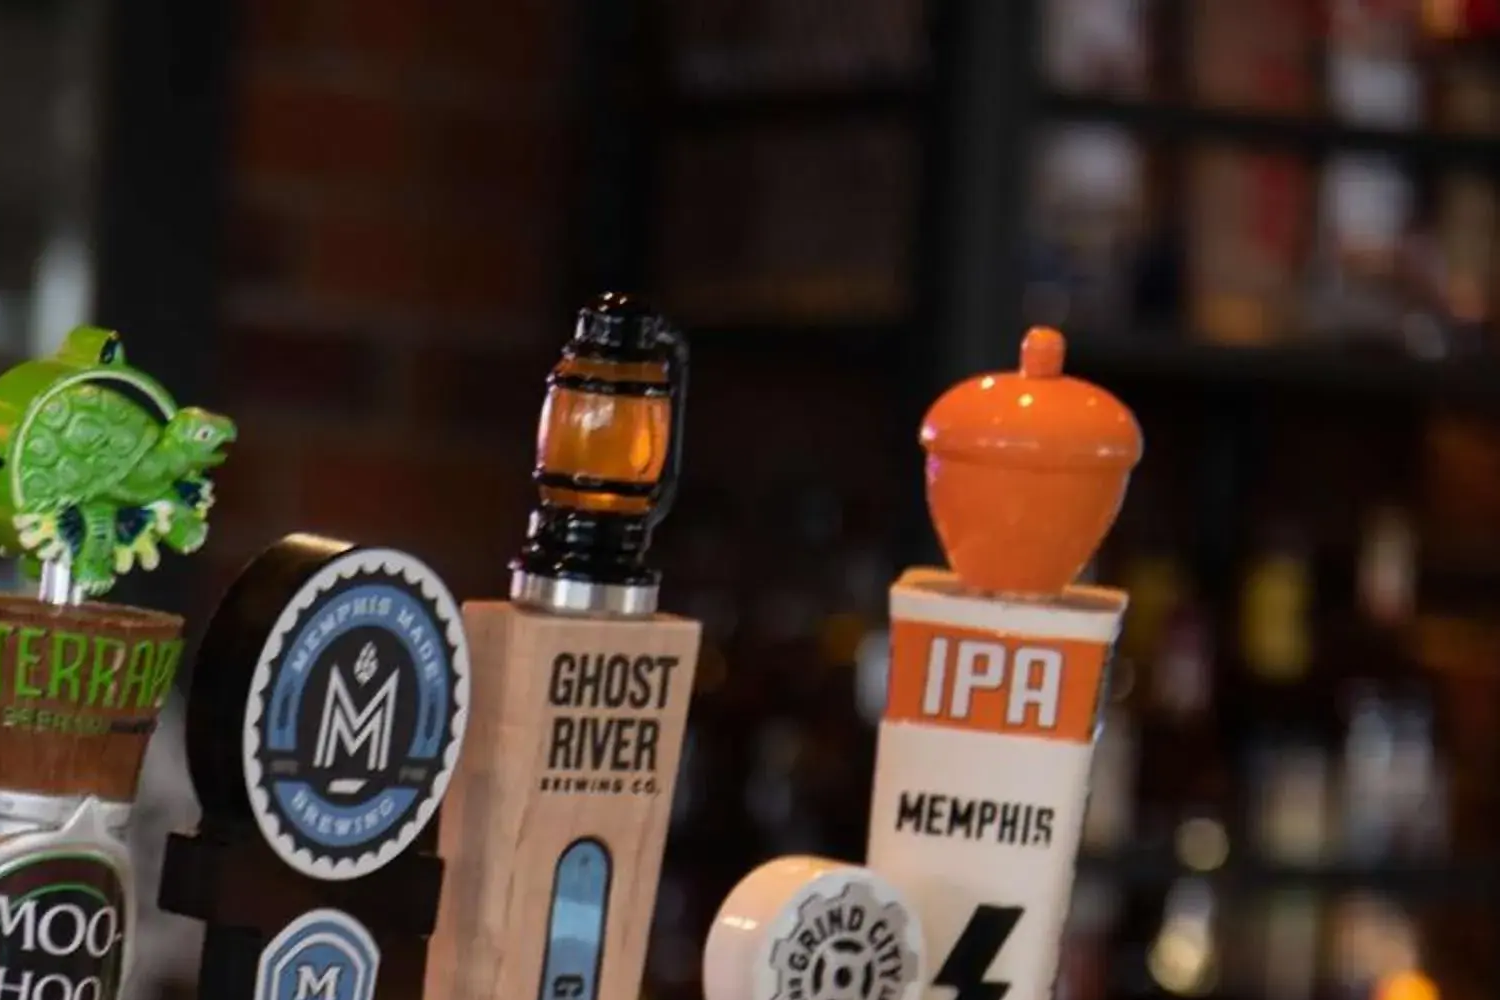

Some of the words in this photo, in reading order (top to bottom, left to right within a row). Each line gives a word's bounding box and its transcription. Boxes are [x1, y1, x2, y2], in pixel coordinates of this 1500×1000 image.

[396, 607, 440, 682] MADE
[548, 651, 680, 710] GHOST
[922, 636, 1063, 729] IPA
[548, 716, 661, 772] RIVER
[894, 789, 1056, 847] MEMPHIS
[788, 905, 865, 972] GRIND
[868, 919, 903, 983] CITY
